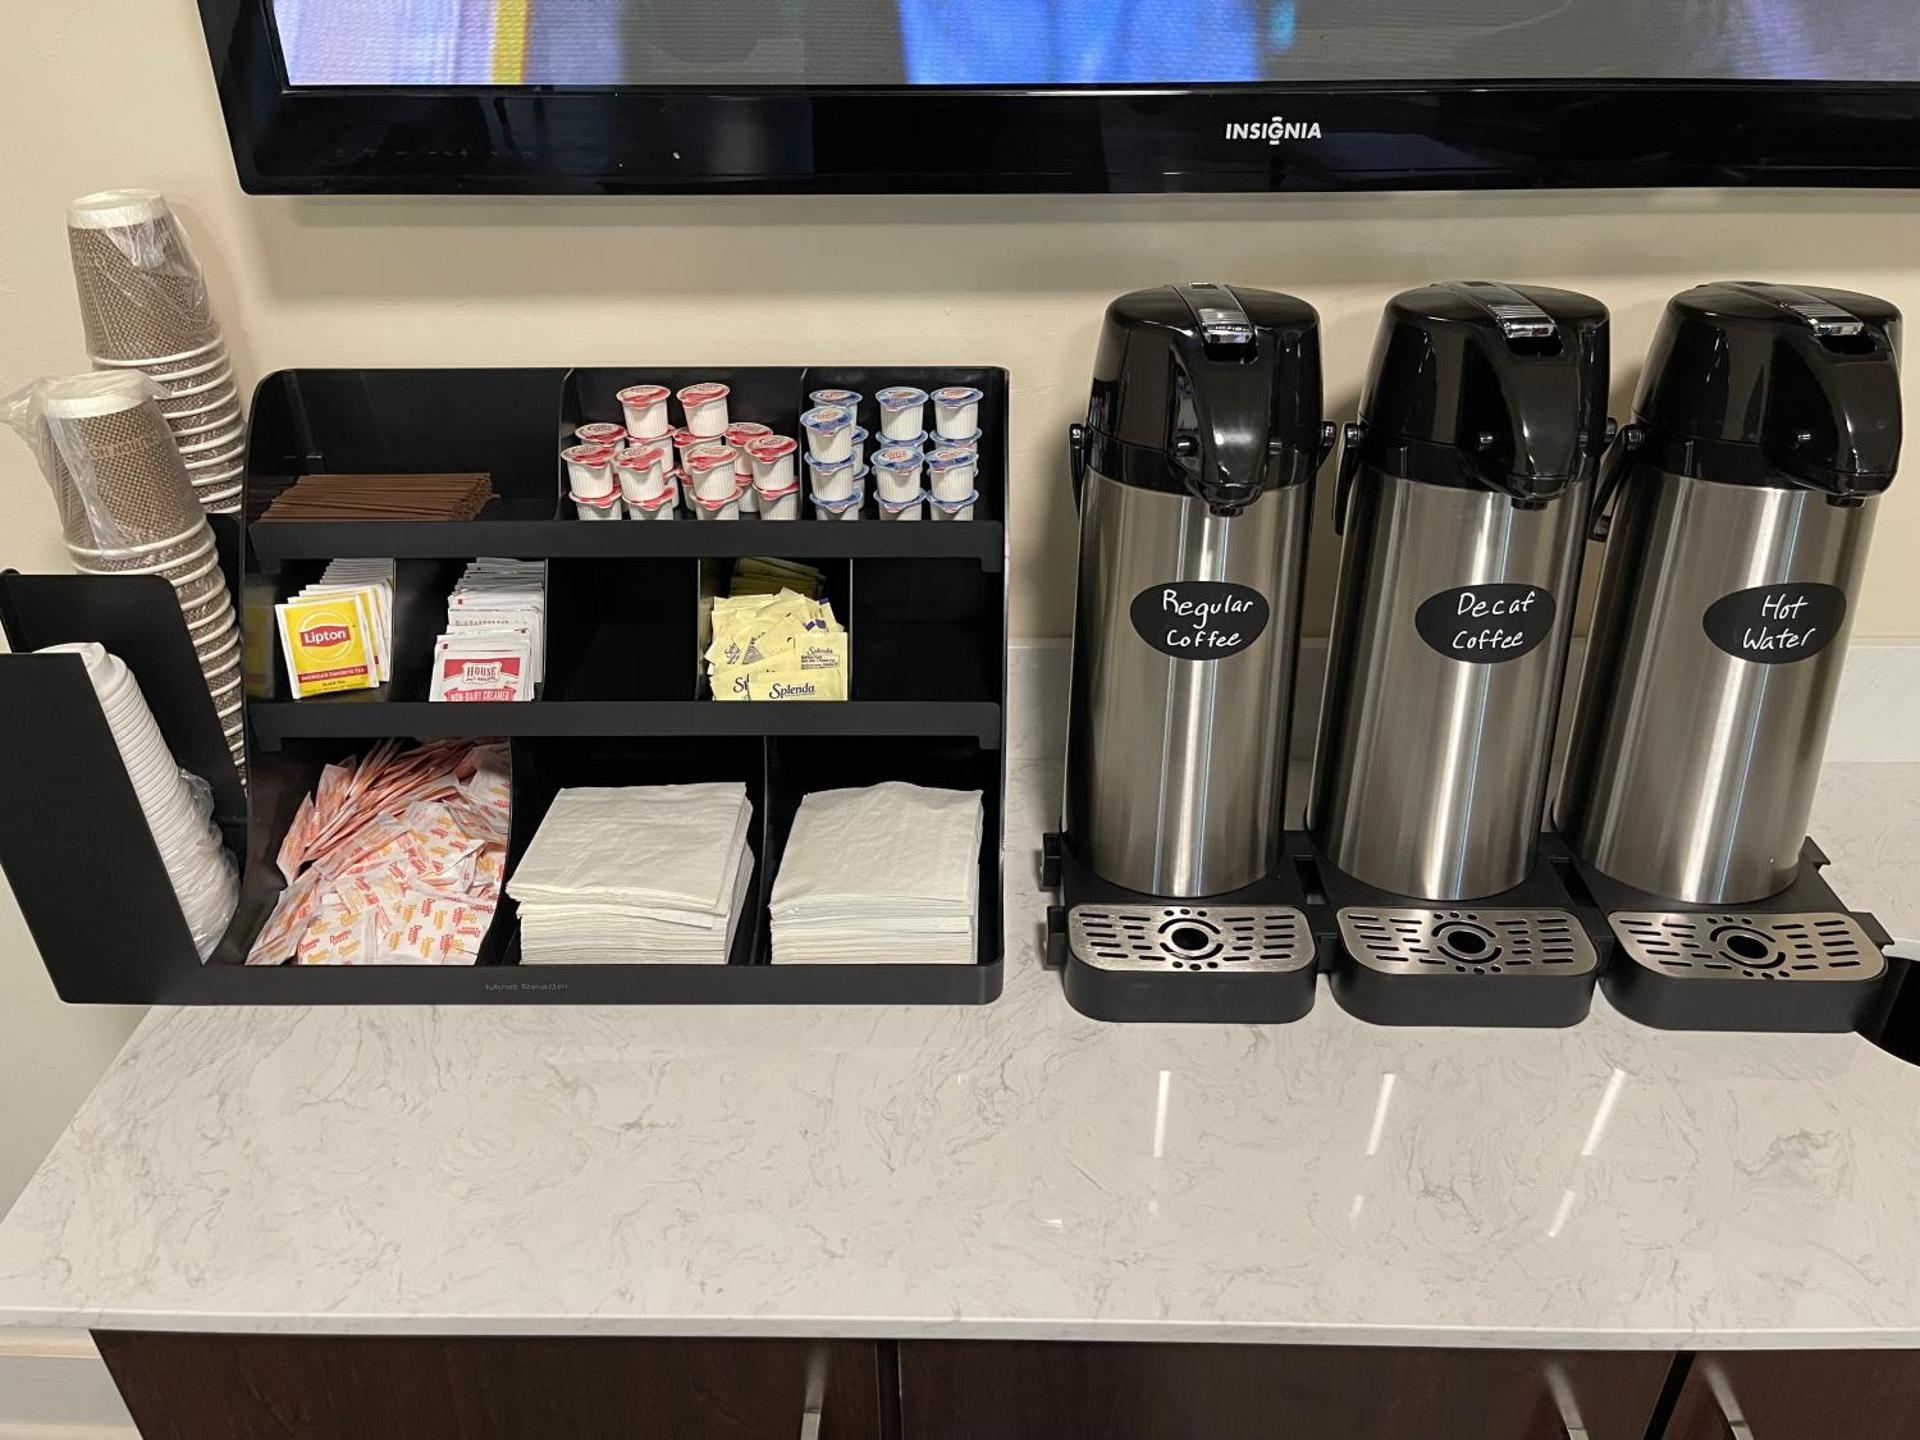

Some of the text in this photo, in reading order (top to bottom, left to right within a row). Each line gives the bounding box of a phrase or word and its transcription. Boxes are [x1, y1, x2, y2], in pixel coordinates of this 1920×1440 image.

[1225, 117, 1322, 144] INSIGNIA
[1162, 588, 1255, 630] Regular
[1456, 590, 1536, 618] Decaf
[1761, 593, 1809, 620] Hot
[304, 630, 347, 645] Lipton
[1166, 629, 1243, 648] Coffee
[1452, 628, 1524, 650] Coffee
[1742, 626, 1817, 651] Water
[466, 664, 498, 677] HOUSE
[769, 683, 815, 699] Splenda
